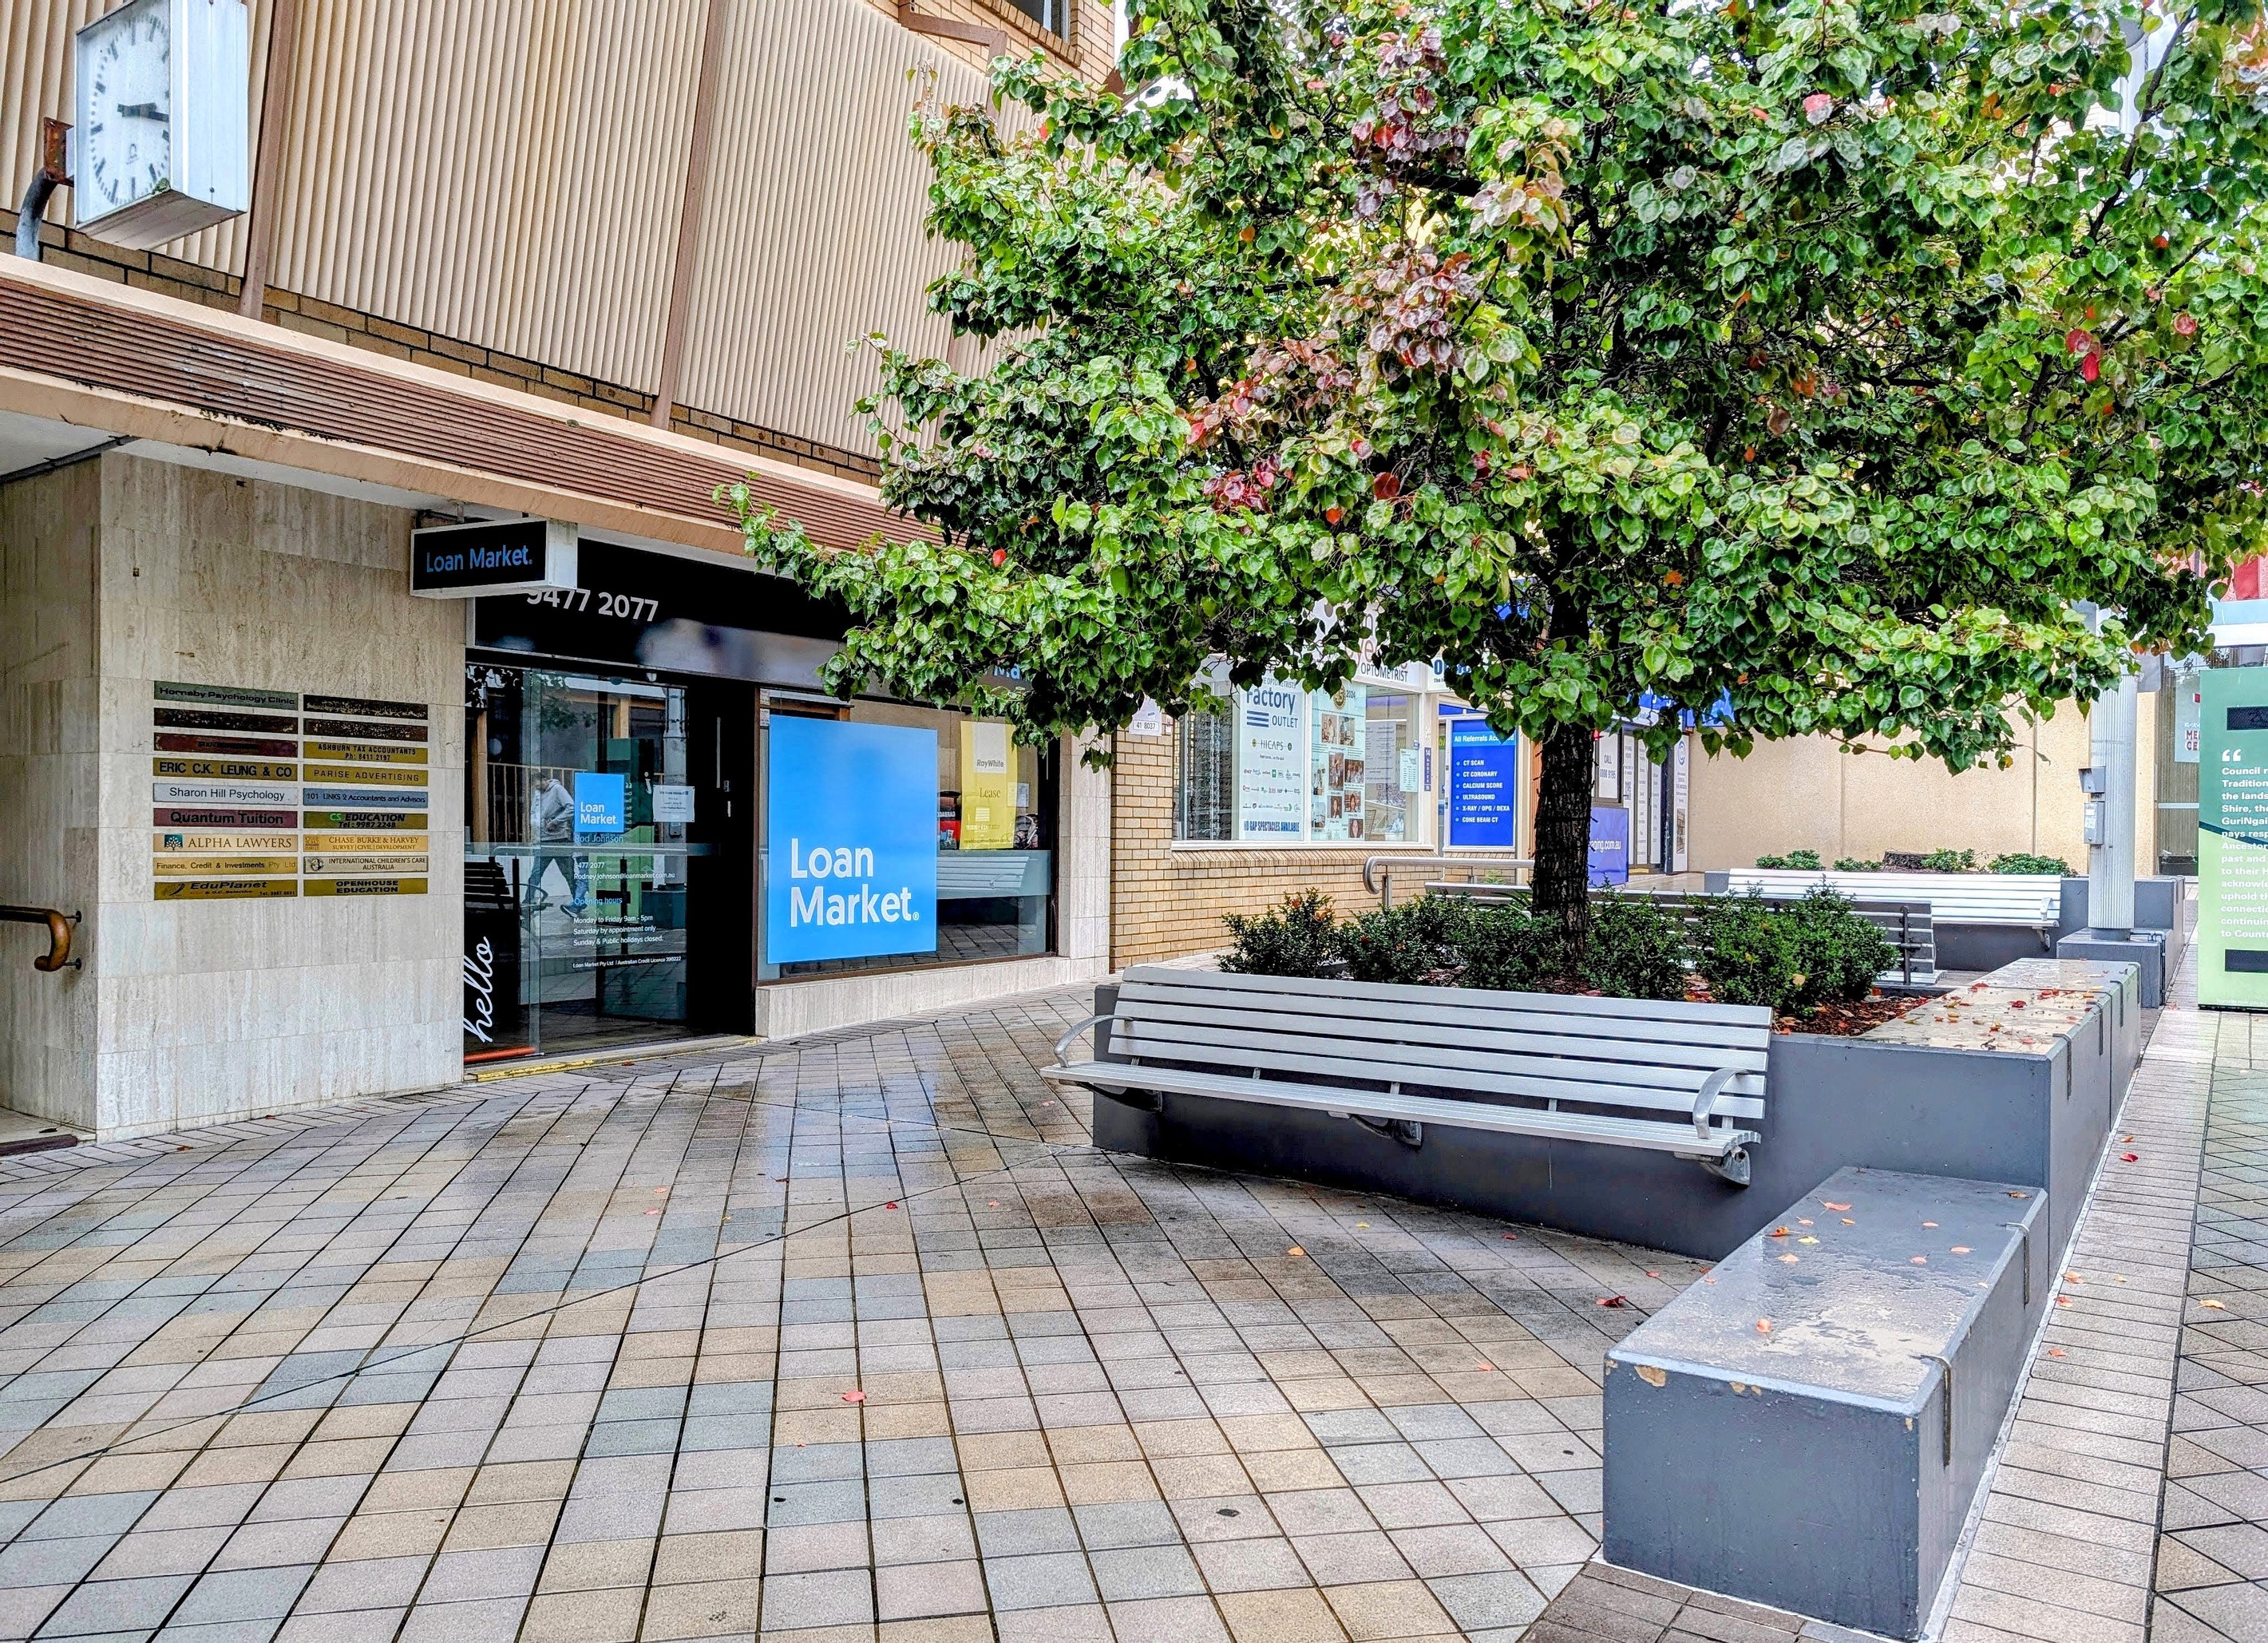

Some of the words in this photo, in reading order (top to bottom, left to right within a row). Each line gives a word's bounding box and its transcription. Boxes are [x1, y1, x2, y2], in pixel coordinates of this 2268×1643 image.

[426, 552, 464, 573] Loan
[598, 592, 659, 622] 2077
[160, 687, 206, 699] Hornsby
[208, 691, 267, 703] Psychology
[268, 696, 295, 705] Clinic
[1346, 690, 1356, 699] 2024
[1246, 687, 1296, 715] Factory
[1272, 715, 1299, 728] OUTLET
[1261, 739, 1284, 750] HICAPS
[368, 746, 416, 755] ACCOUNTANTS
[160, 762, 186, 773] ERIC
[192, 763, 214, 774] C.K.
[220, 764, 257, 776] LEUNG
[263, 766, 270, 776] &
[276, 766, 292, 777] CO
[2222, 766, 2261, 775] Council
[314, 769, 350, 778] PARISE
[354, 771, 419, 782] ADVERTISING
[169, 787, 208, 798] Sharon
[210, 789, 226, 798] Hill
[229, 789, 285, 802] Psychology
[980, 787, 1001, 798] Lease
[580, 802, 604, 813] Loan
[2222, 804, 2252, 814] Shire,
[170, 811, 235, 824] Quantum
[237, 812, 283, 824] Tuition
[1257, 821, 1280, 831] SPECTACLES
[1280, 822, 1300, 832] AVAILABLE
[575, 833, 590, 842] Rod
[592, 833, 623, 843] Johnson
[2222, 831, 2246, 840] pays
[188, 837, 232, 848] ALPHA
[236, 837, 292, 848] LAWYERS
[790, 837, 874, 879] Loan
[2221, 856, 2243, 865] past
[190, 881, 267, 890] EduPlanet
[575, 897, 603, 905] Opening
[2221, 893, 2257, 901] uphold
[463, 936, 493, 1043] hello
